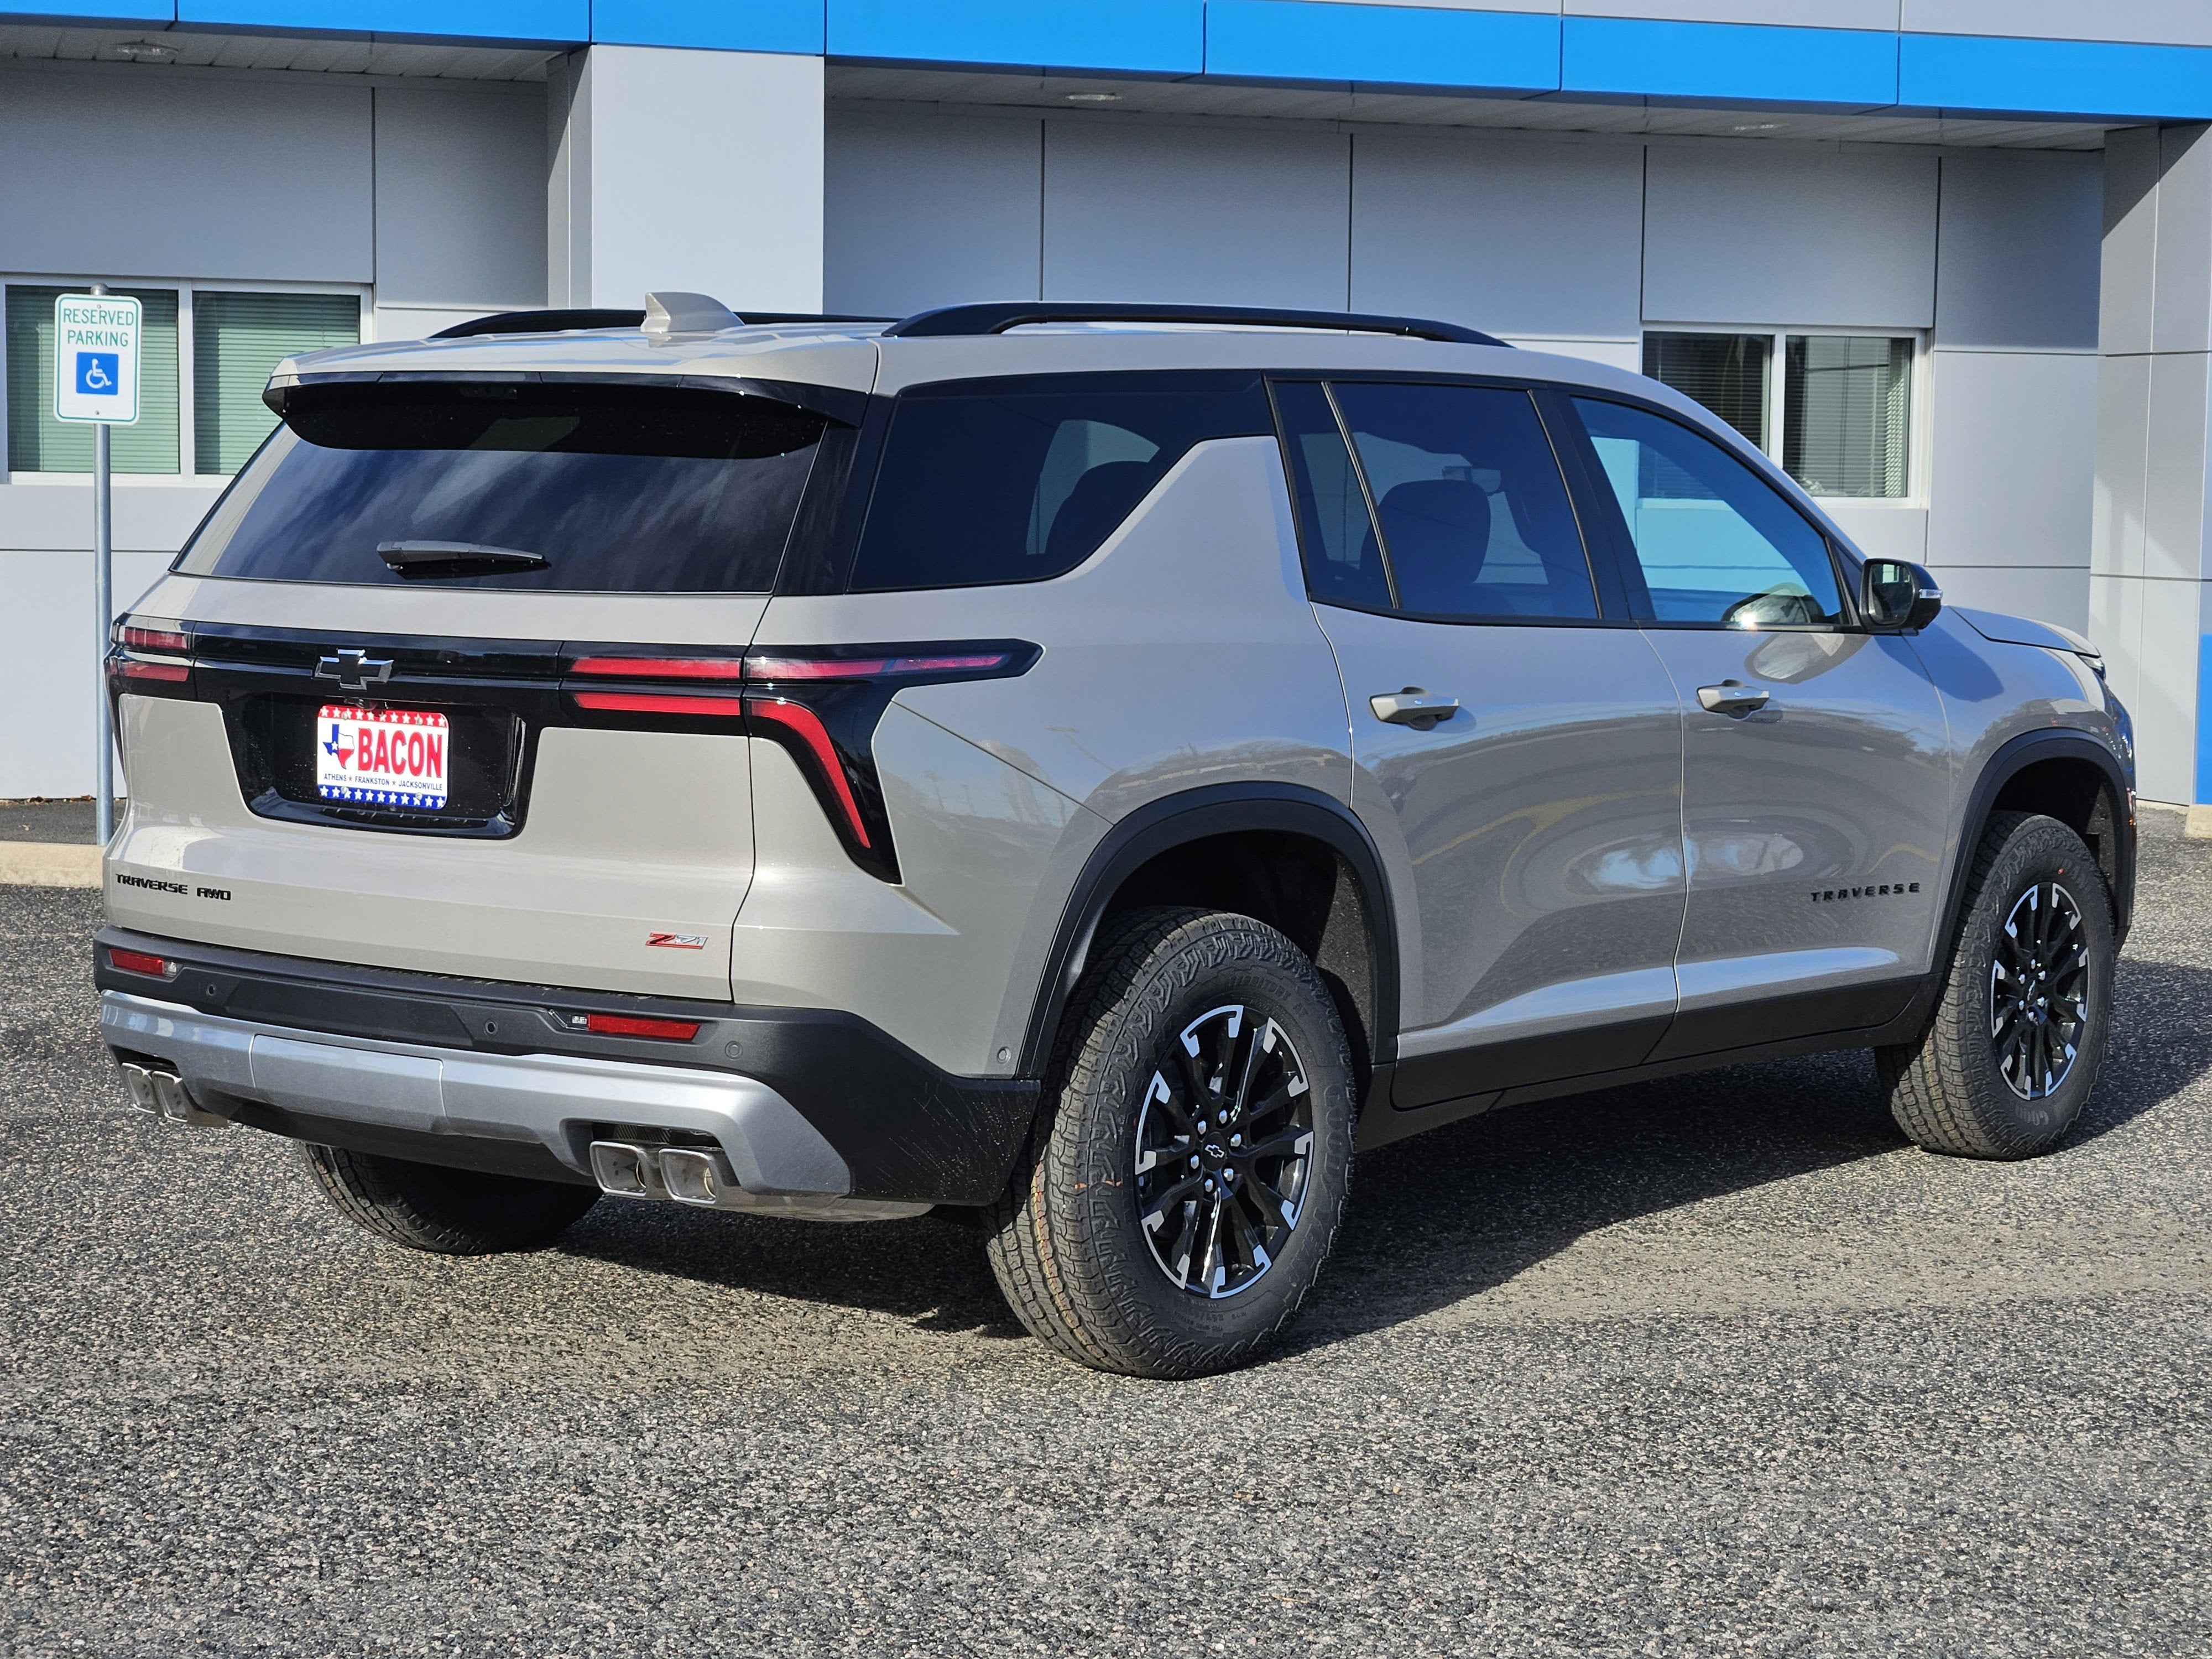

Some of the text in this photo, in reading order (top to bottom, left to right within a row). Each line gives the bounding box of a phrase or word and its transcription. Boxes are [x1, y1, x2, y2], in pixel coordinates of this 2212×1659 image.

[62, 307, 134, 326] RESERVED
[67, 330, 129, 347] PARKING
[358, 727, 444, 779] BACON
[324, 773, 443, 791] ATHENS FRANKSTON JACKSONVILLE
[115, 873, 231, 901] TRAVERSE AWD
[1810, 881, 1921, 902] TRAVERSE
[645, 932, 709, 950] Z71
